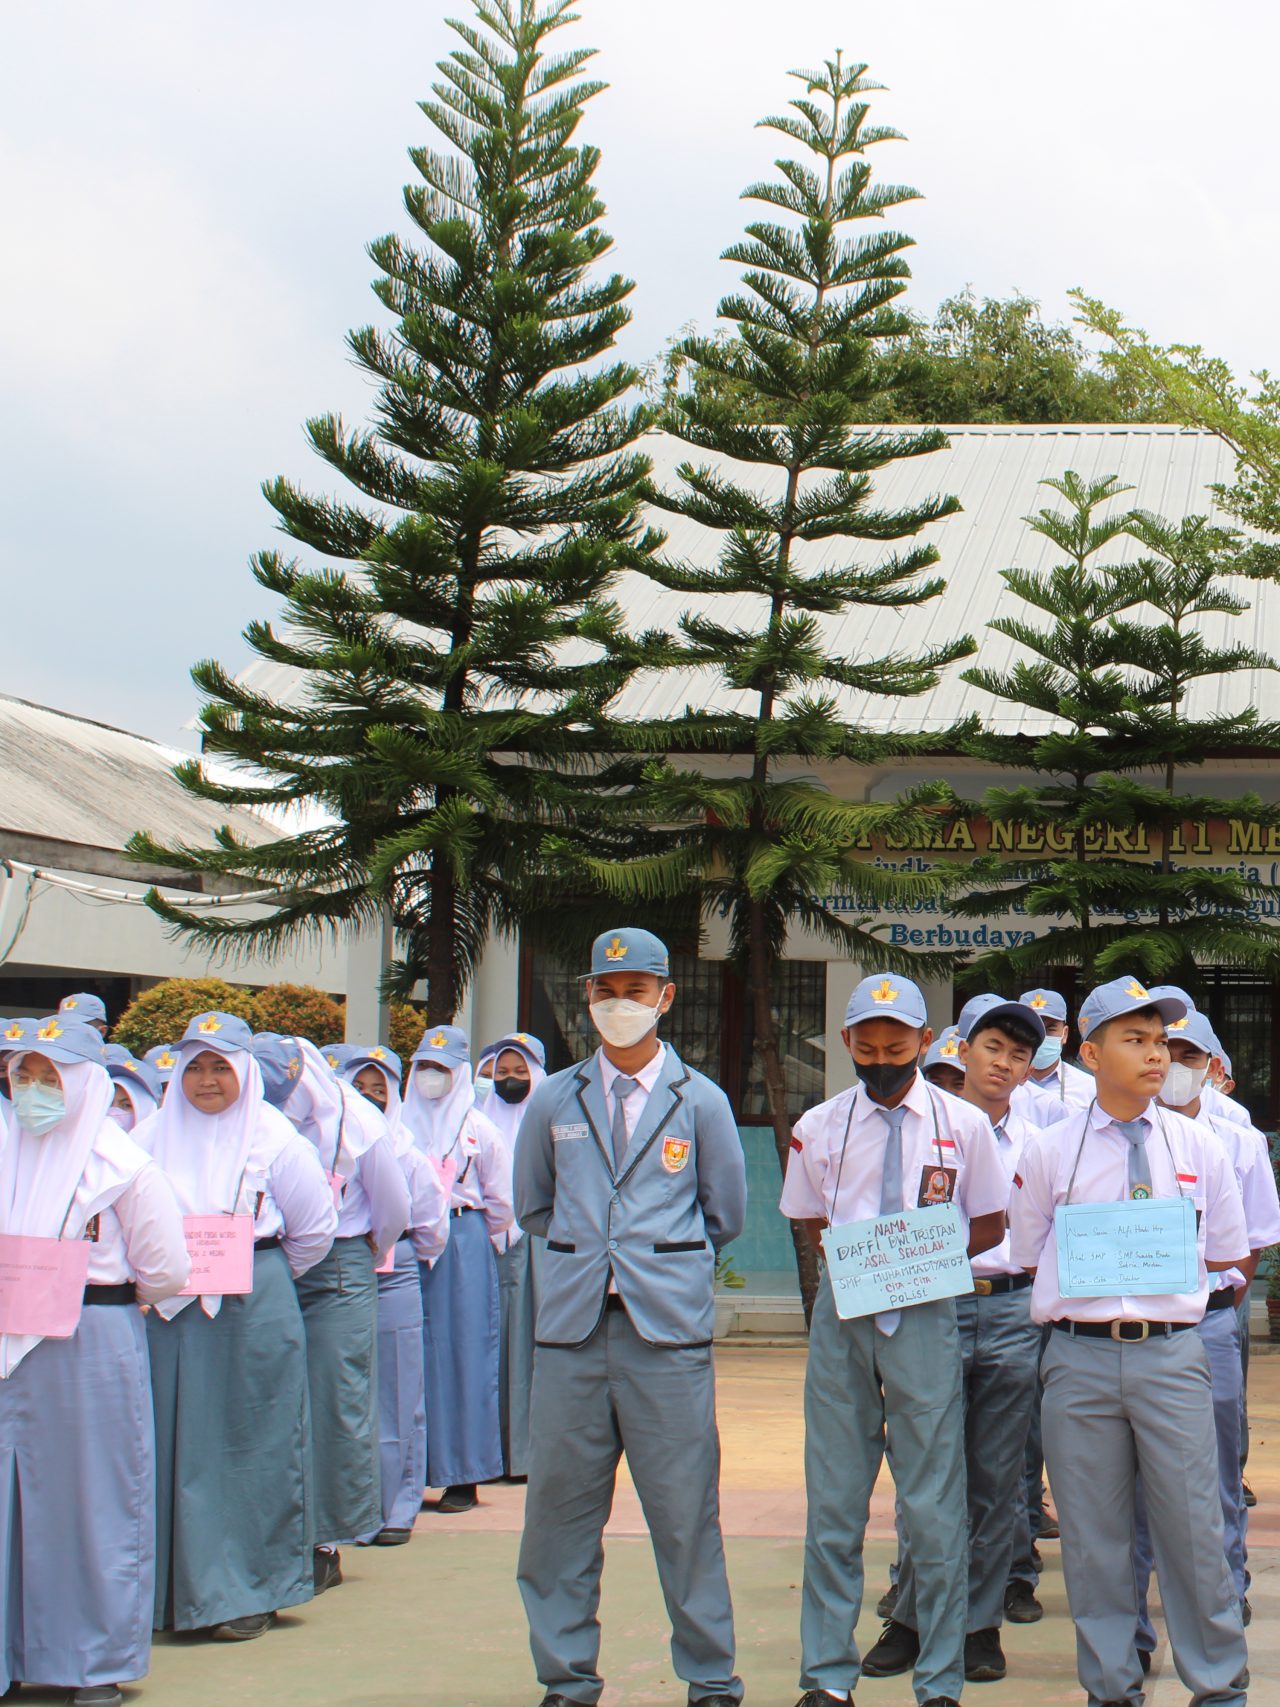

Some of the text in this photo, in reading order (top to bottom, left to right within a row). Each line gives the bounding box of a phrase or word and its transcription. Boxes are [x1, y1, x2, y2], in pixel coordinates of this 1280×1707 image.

[988, 819, 1150, 852] NEGERI
[1168, 819, 1212, 854] 11
[889, 923, 1036, 949] Berbudaya
[874, 1219, 908, 1237] NAMA
[864, 1240, 945, 1270] ASAL SEKOLAH
[839, 1276, 862, 1290] SMP
